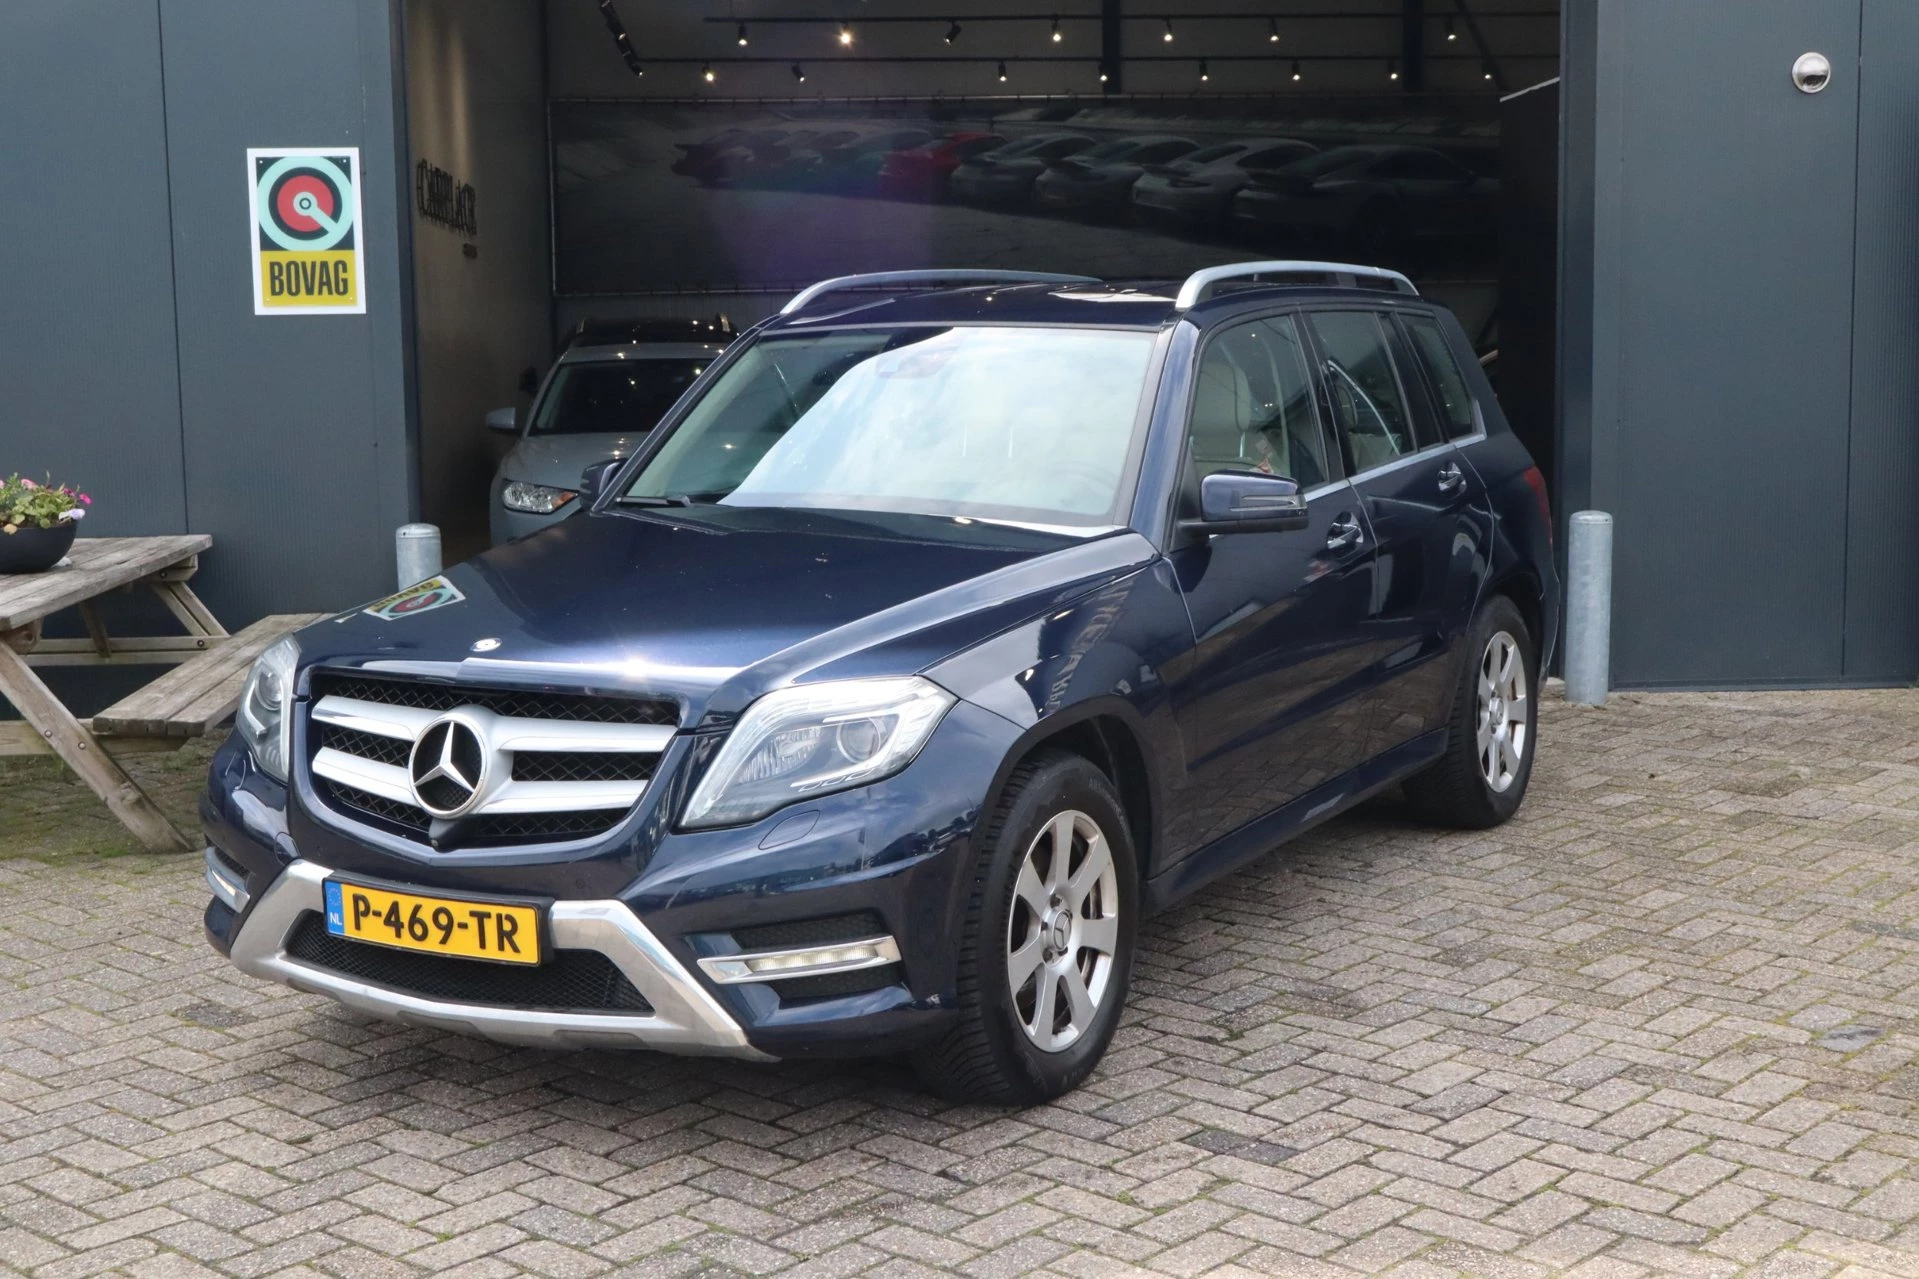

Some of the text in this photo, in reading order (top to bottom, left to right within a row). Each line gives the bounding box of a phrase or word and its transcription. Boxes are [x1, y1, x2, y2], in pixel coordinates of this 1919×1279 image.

[269, 260, 349, 297] BOVAG
[329, 893, 521, 954] NL P-469-TR
